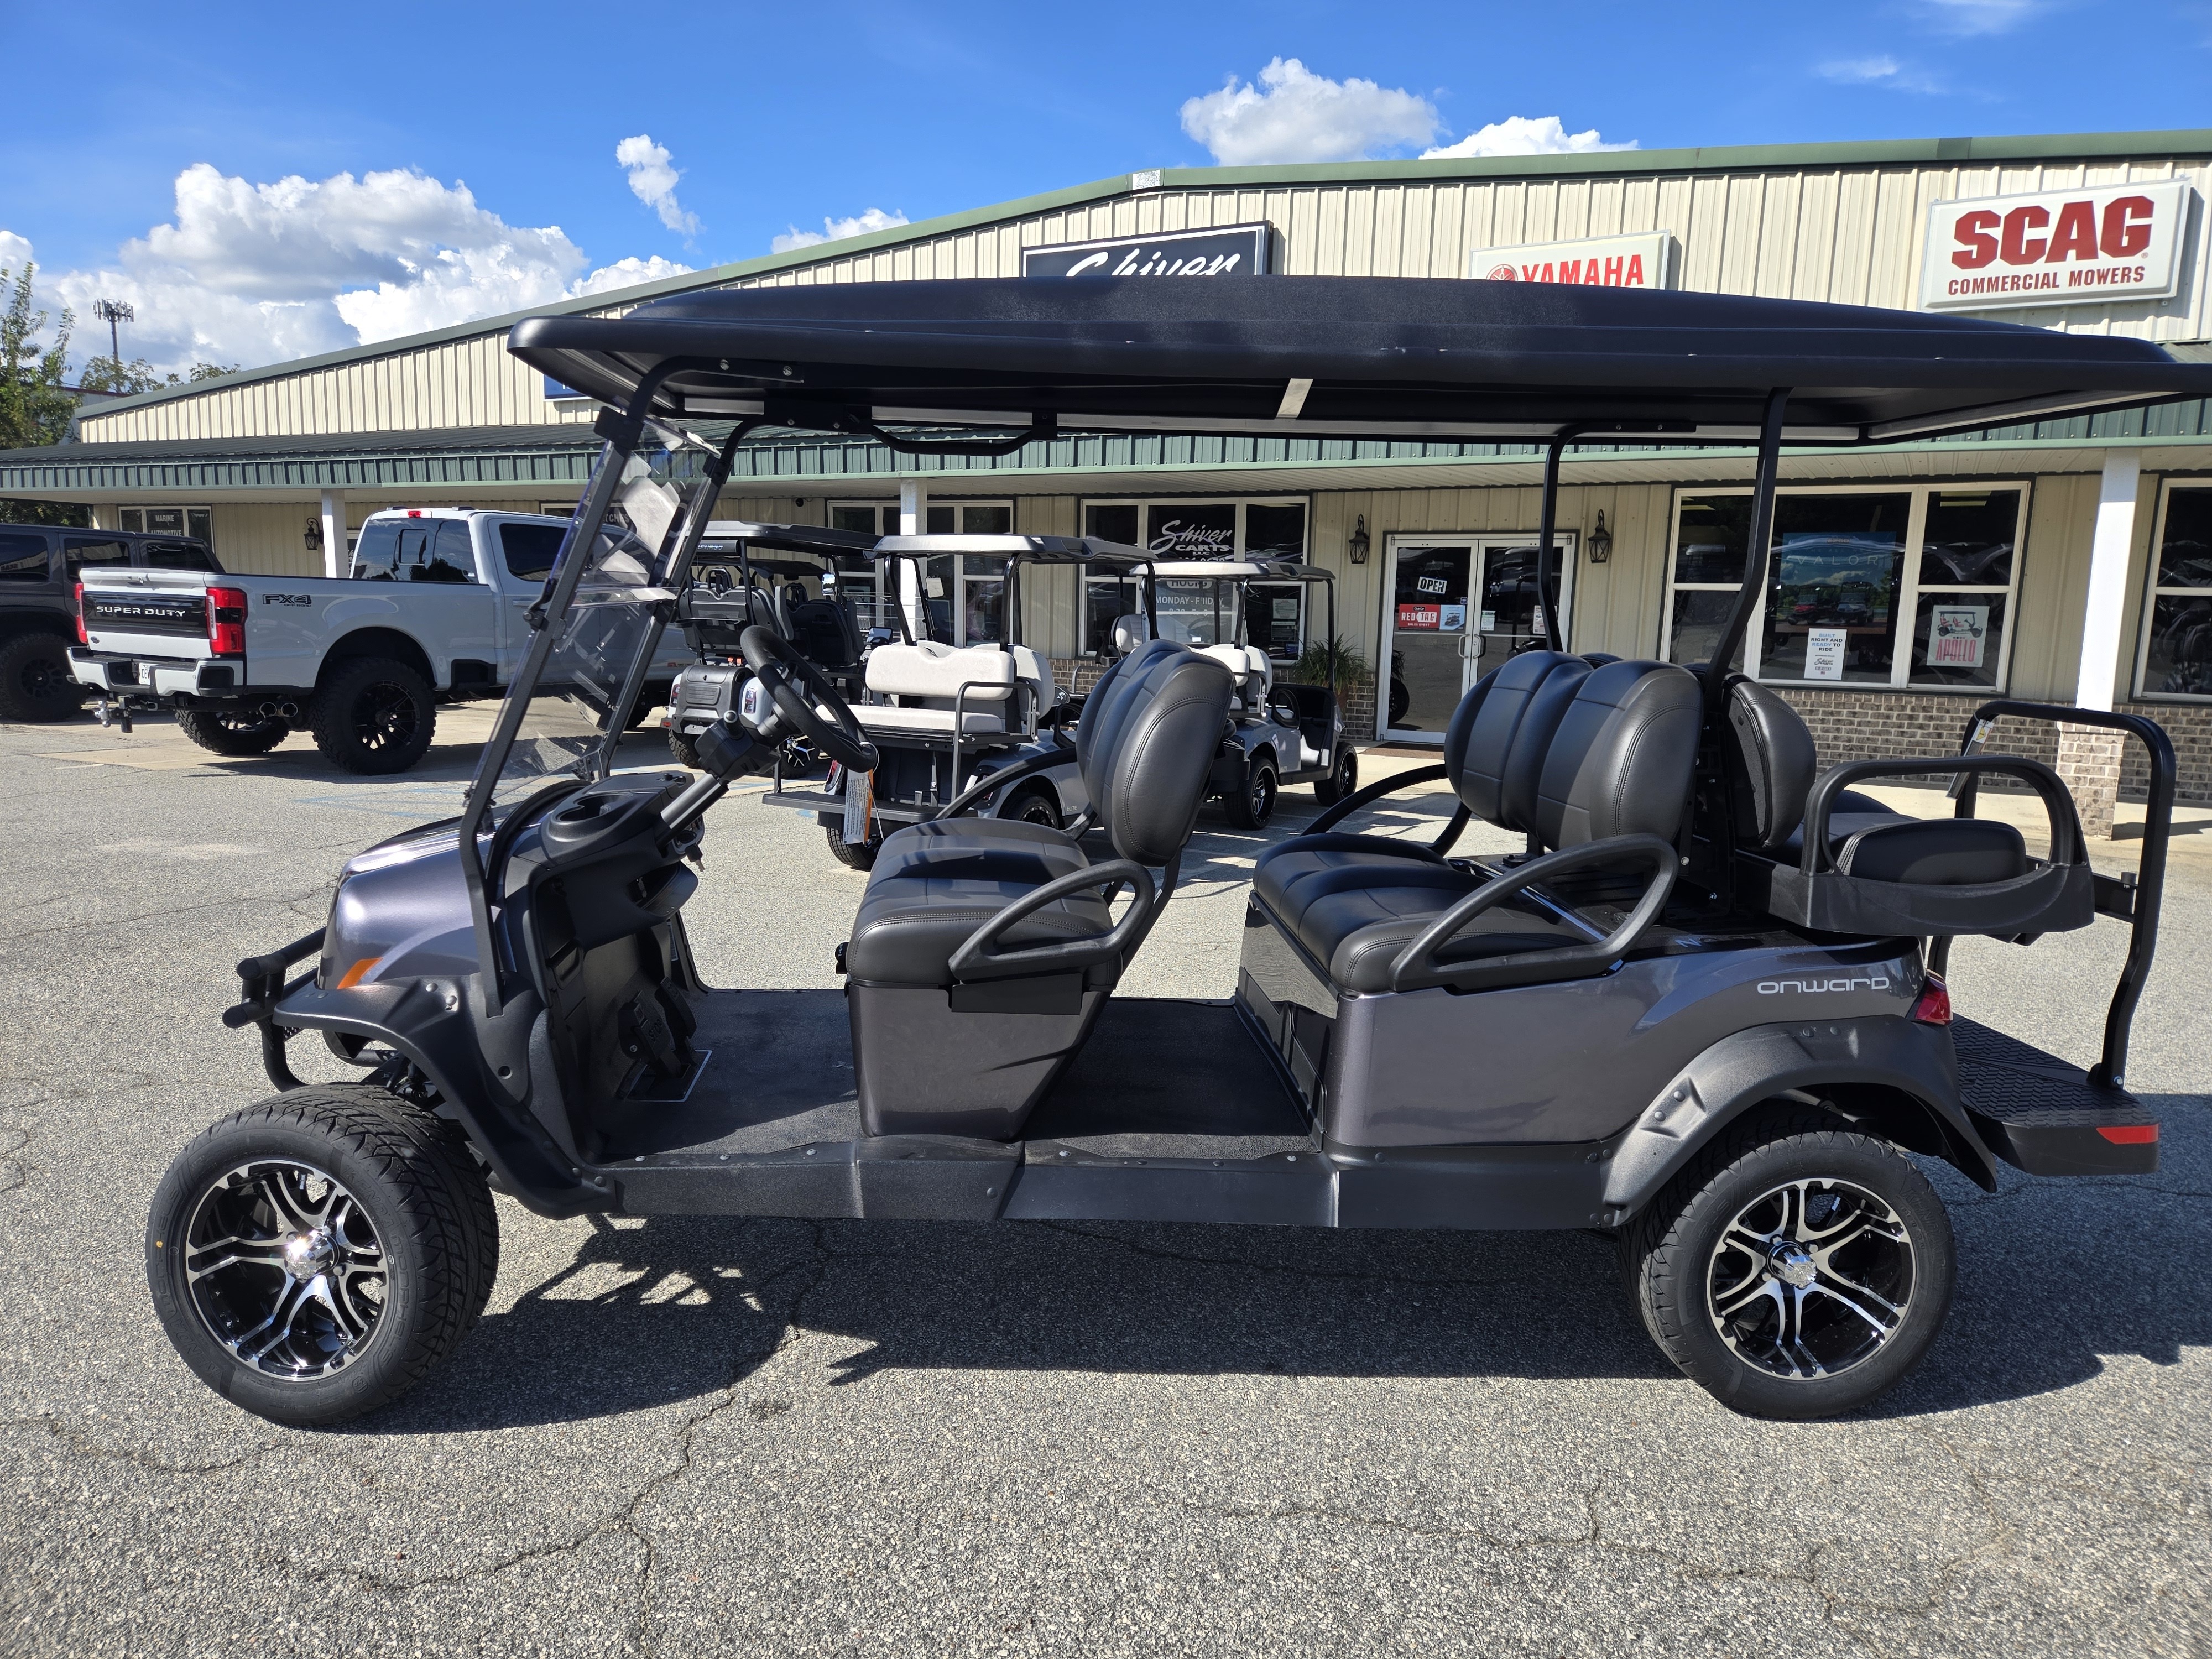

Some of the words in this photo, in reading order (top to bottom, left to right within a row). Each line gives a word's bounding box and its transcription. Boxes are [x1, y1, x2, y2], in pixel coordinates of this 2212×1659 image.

[1951, 195, 2155, 270] SCAG
[1521, 254, 1644, 286] YAMAHA
[1948, 270, 2060, 296] COMMERCIAL
[2068, 265, 2146, 288] MOWERS
[1150, 520, 1233, 554] Shiver
[1797, 555, 1879, 565] VALOR
[1420, 578, 1445, 593] OPEN
[262, 593, 312, 605] FX4
[1156, 596, 1190, 604] MONDAY
[96, 606, 141, 614] SUPER
[144, 608, 186, 617] DUTY
[1401, 612, 1416, 621] RED
[1420, 613, 1434, 622] TAG
[1936, 638, 1977, 662] APOLLO
